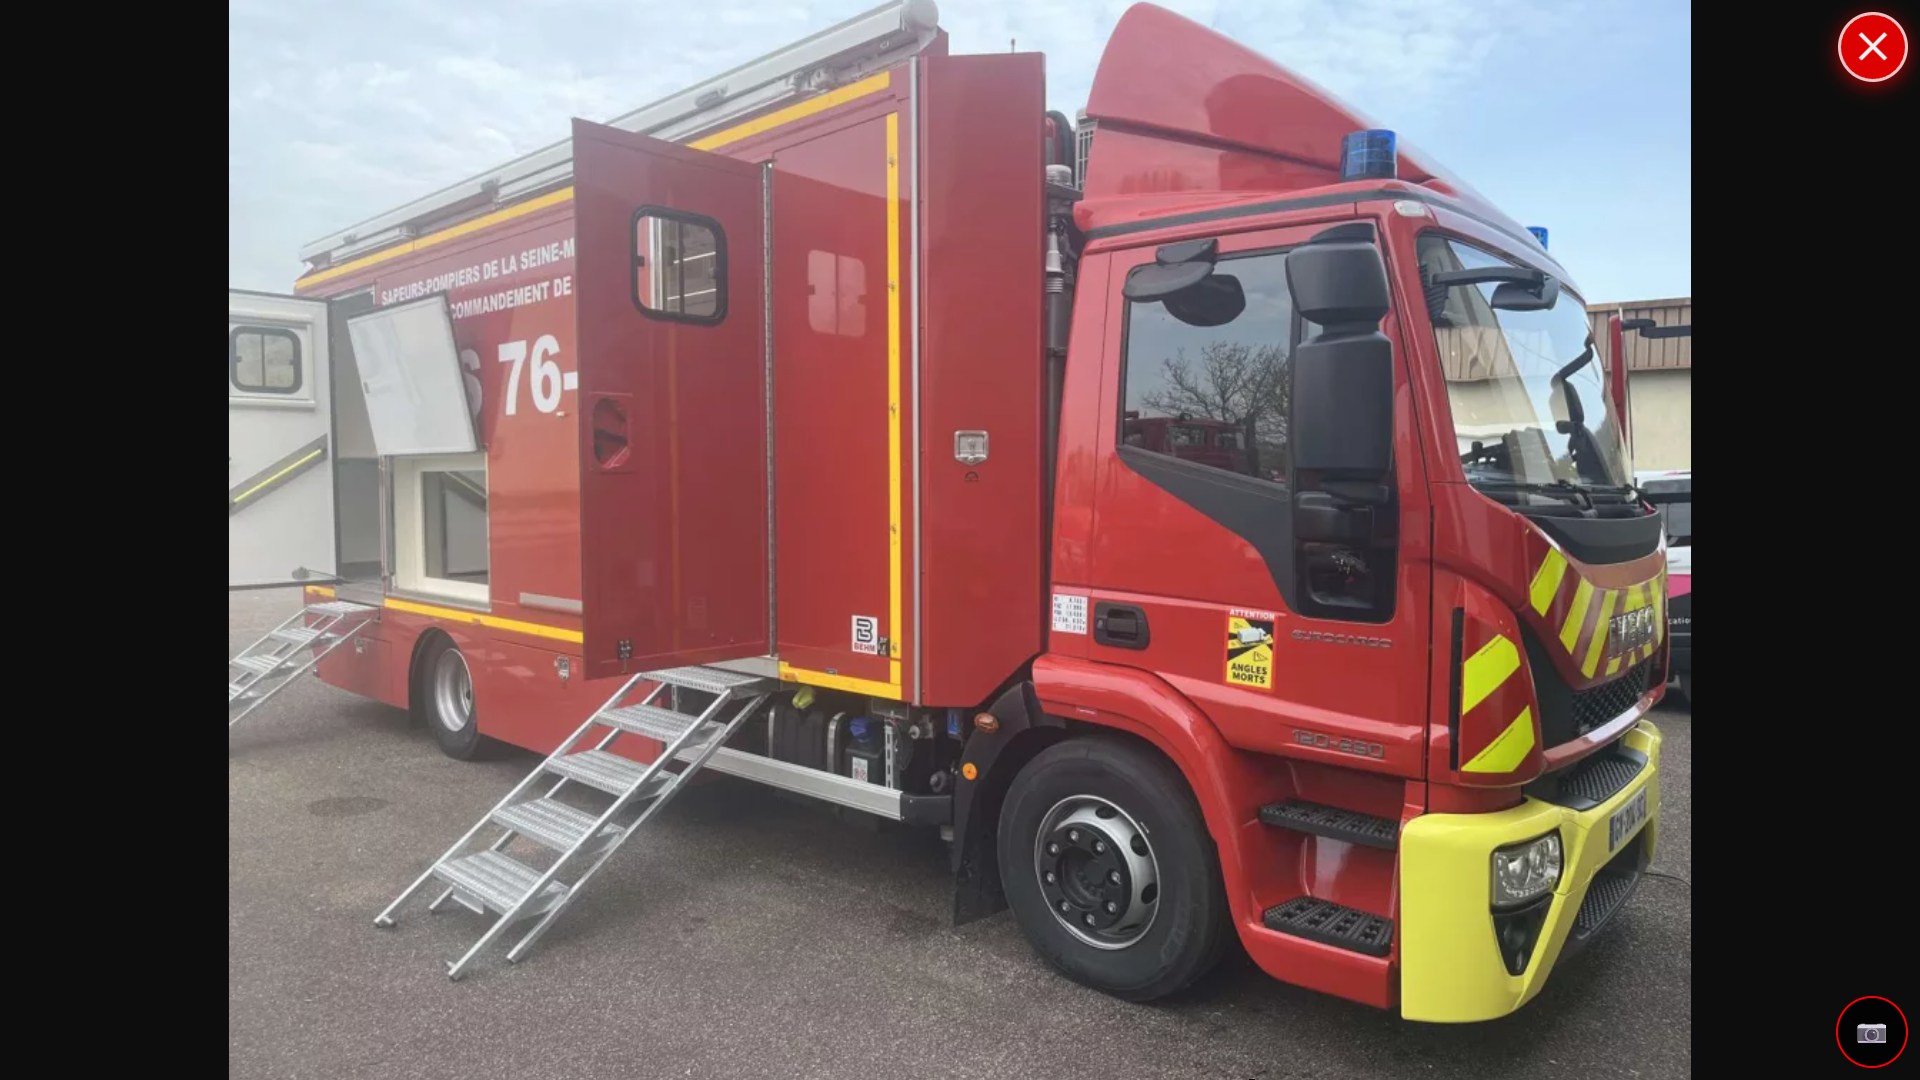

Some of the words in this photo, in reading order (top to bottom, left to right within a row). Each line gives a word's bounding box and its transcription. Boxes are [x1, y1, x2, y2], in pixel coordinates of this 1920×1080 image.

[381, 265, 480, 306] SAPEURS-POMPIERS
[483, 259, 499, 280] DE
[502, 255, 518, 275] LA
[553, 275, 572, 297] DE
[1229, 608, 1275, 620] ATTENTION
[1291, 629, 1392, 648] EUROCARGO
[854, 642, 875, 652] BEHM
[1231, 663, 1267, 675] ANGLES
[1232, 672, 1265, 684] MORTS
